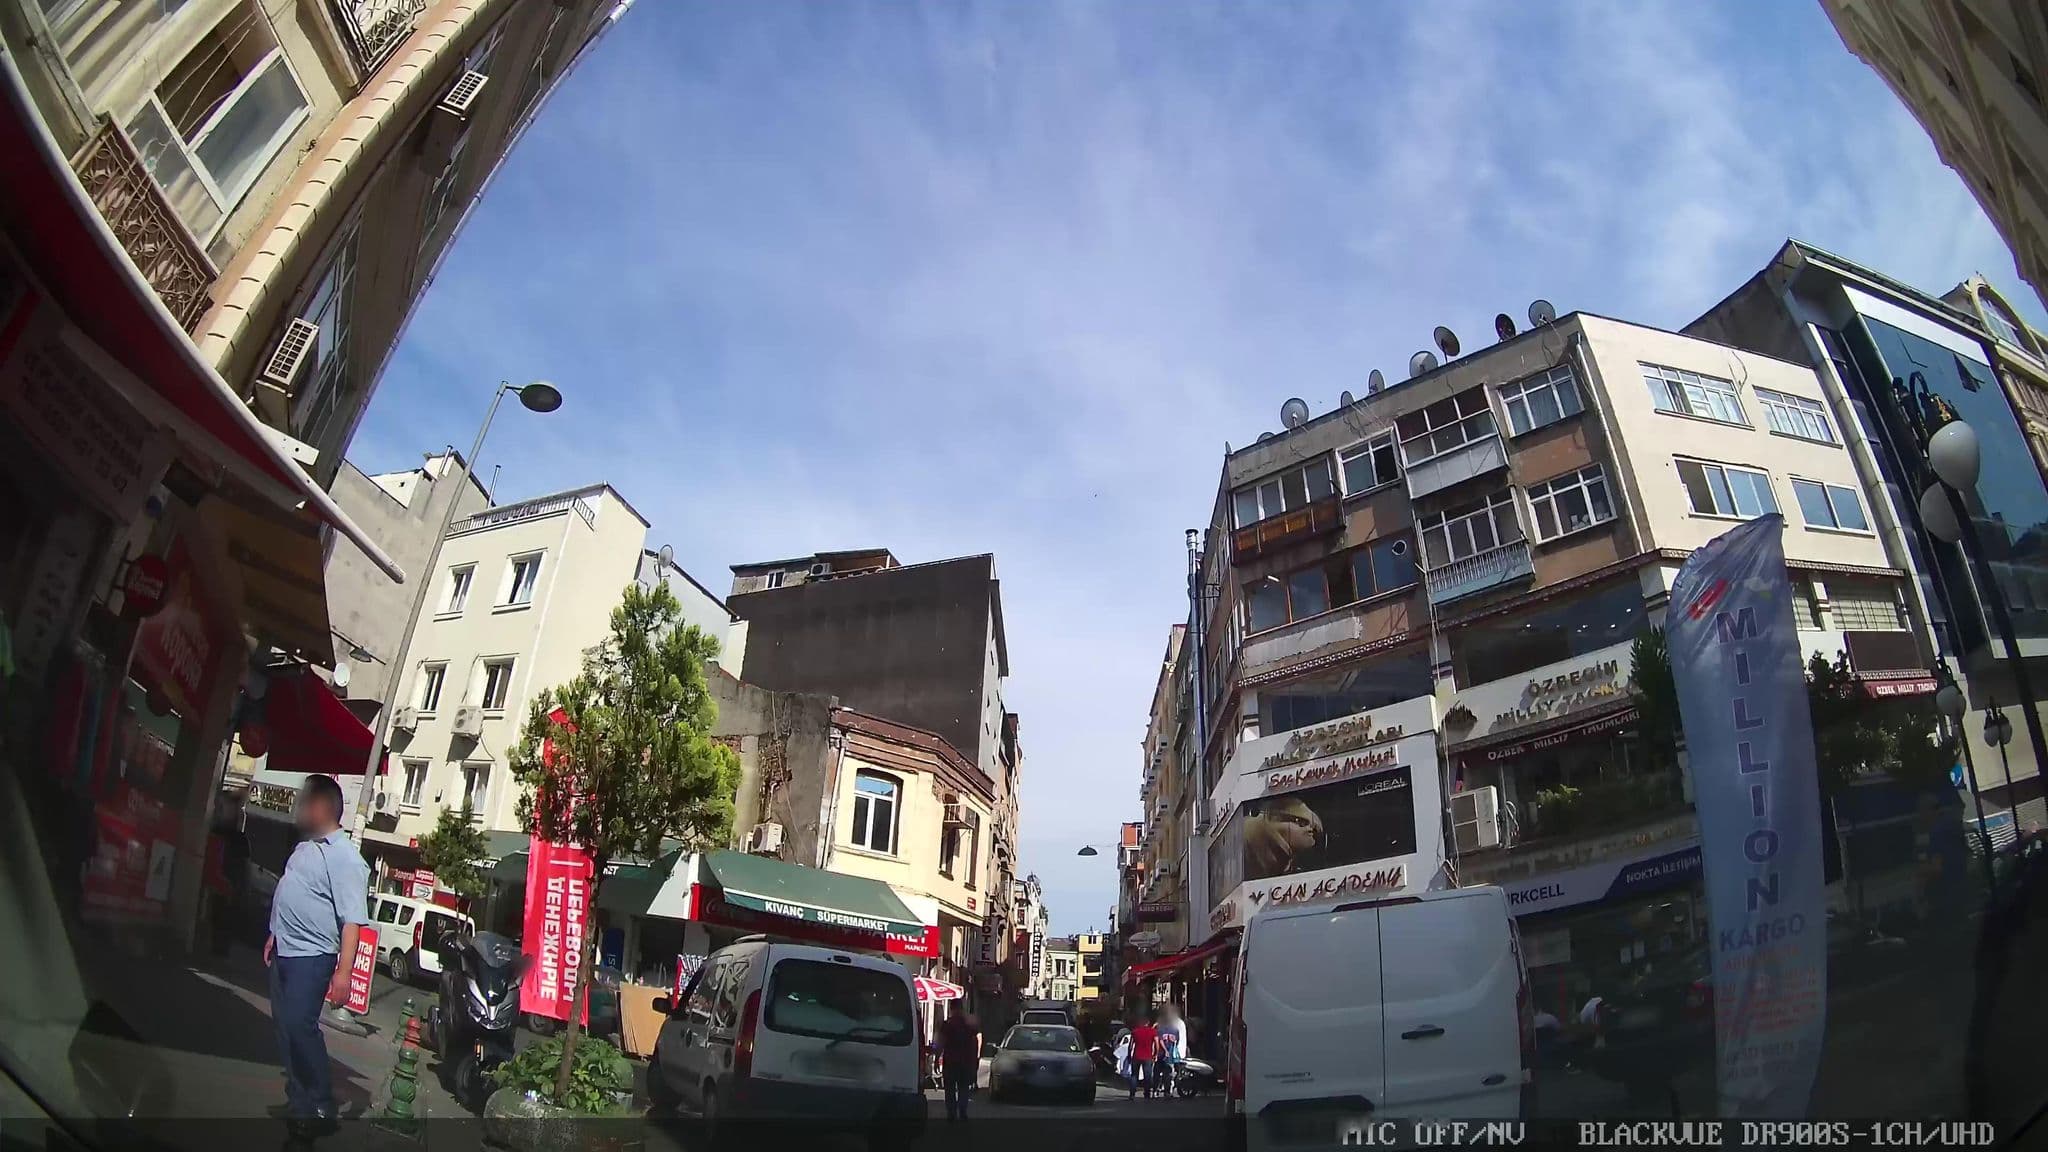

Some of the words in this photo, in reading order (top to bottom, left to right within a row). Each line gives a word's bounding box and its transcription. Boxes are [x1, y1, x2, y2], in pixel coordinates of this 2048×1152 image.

[1716, 606, 1780, 912] MILLION
[1271, 882, 1307, 901] CAN
[1310, 865, 1402, 898] ACADEMY
[1719, 912, 1806, 952] KARGO
